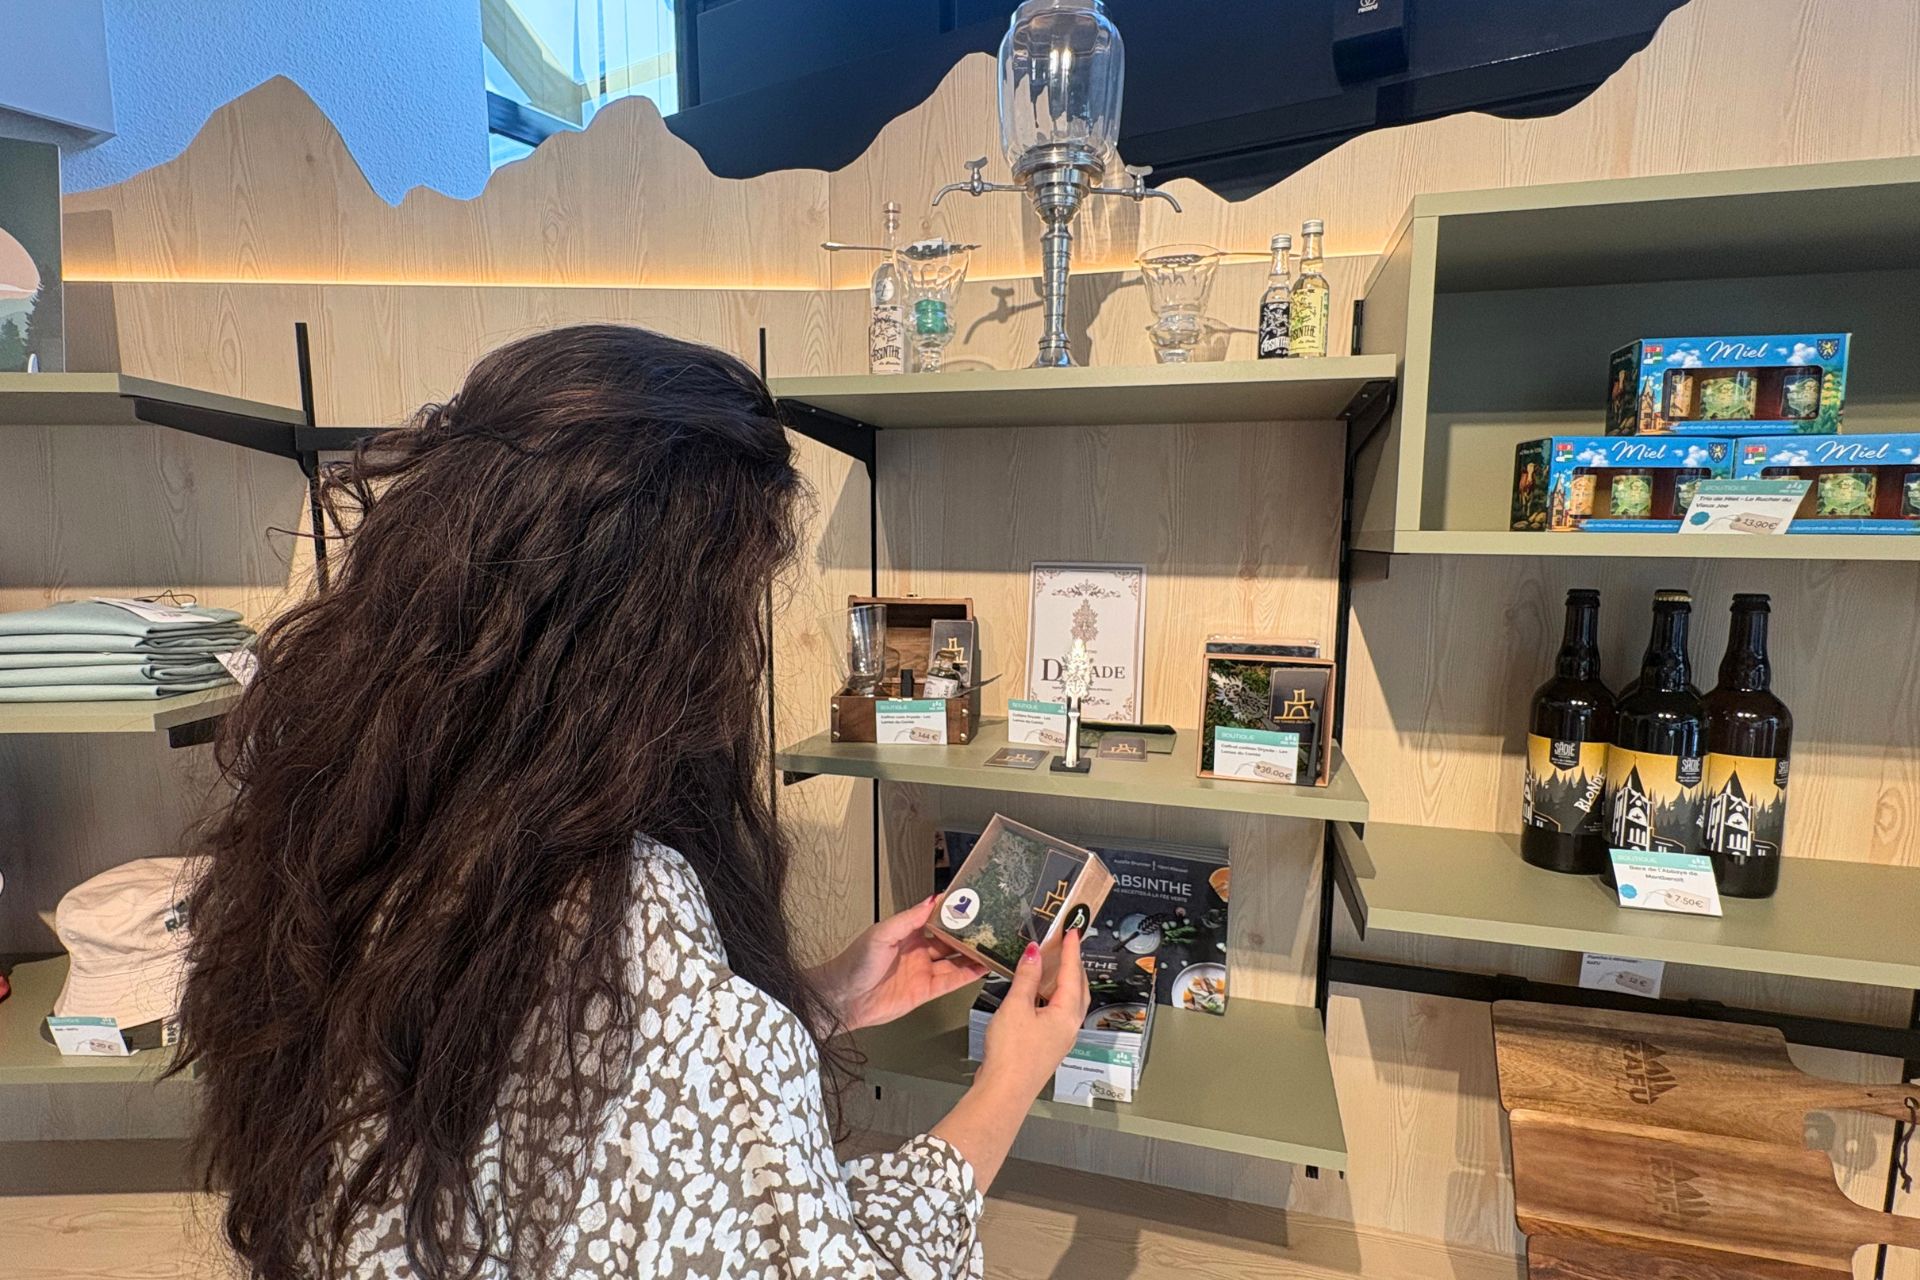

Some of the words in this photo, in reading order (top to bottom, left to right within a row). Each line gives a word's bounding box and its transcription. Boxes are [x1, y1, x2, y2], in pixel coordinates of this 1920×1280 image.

[1705, 340, 1769, 363] Miel
[1611, 440, 1667, 462] Miel
[1815, 440, 1890, 463] Miel
[1743, 518, 1778, 530] 13.90€
[1221, 732, 1255, 740] BOUTIQUE
[1573, 771, 1606, 813] BLONDE
[1112, 873, 1192, 896] ABSINTHE
